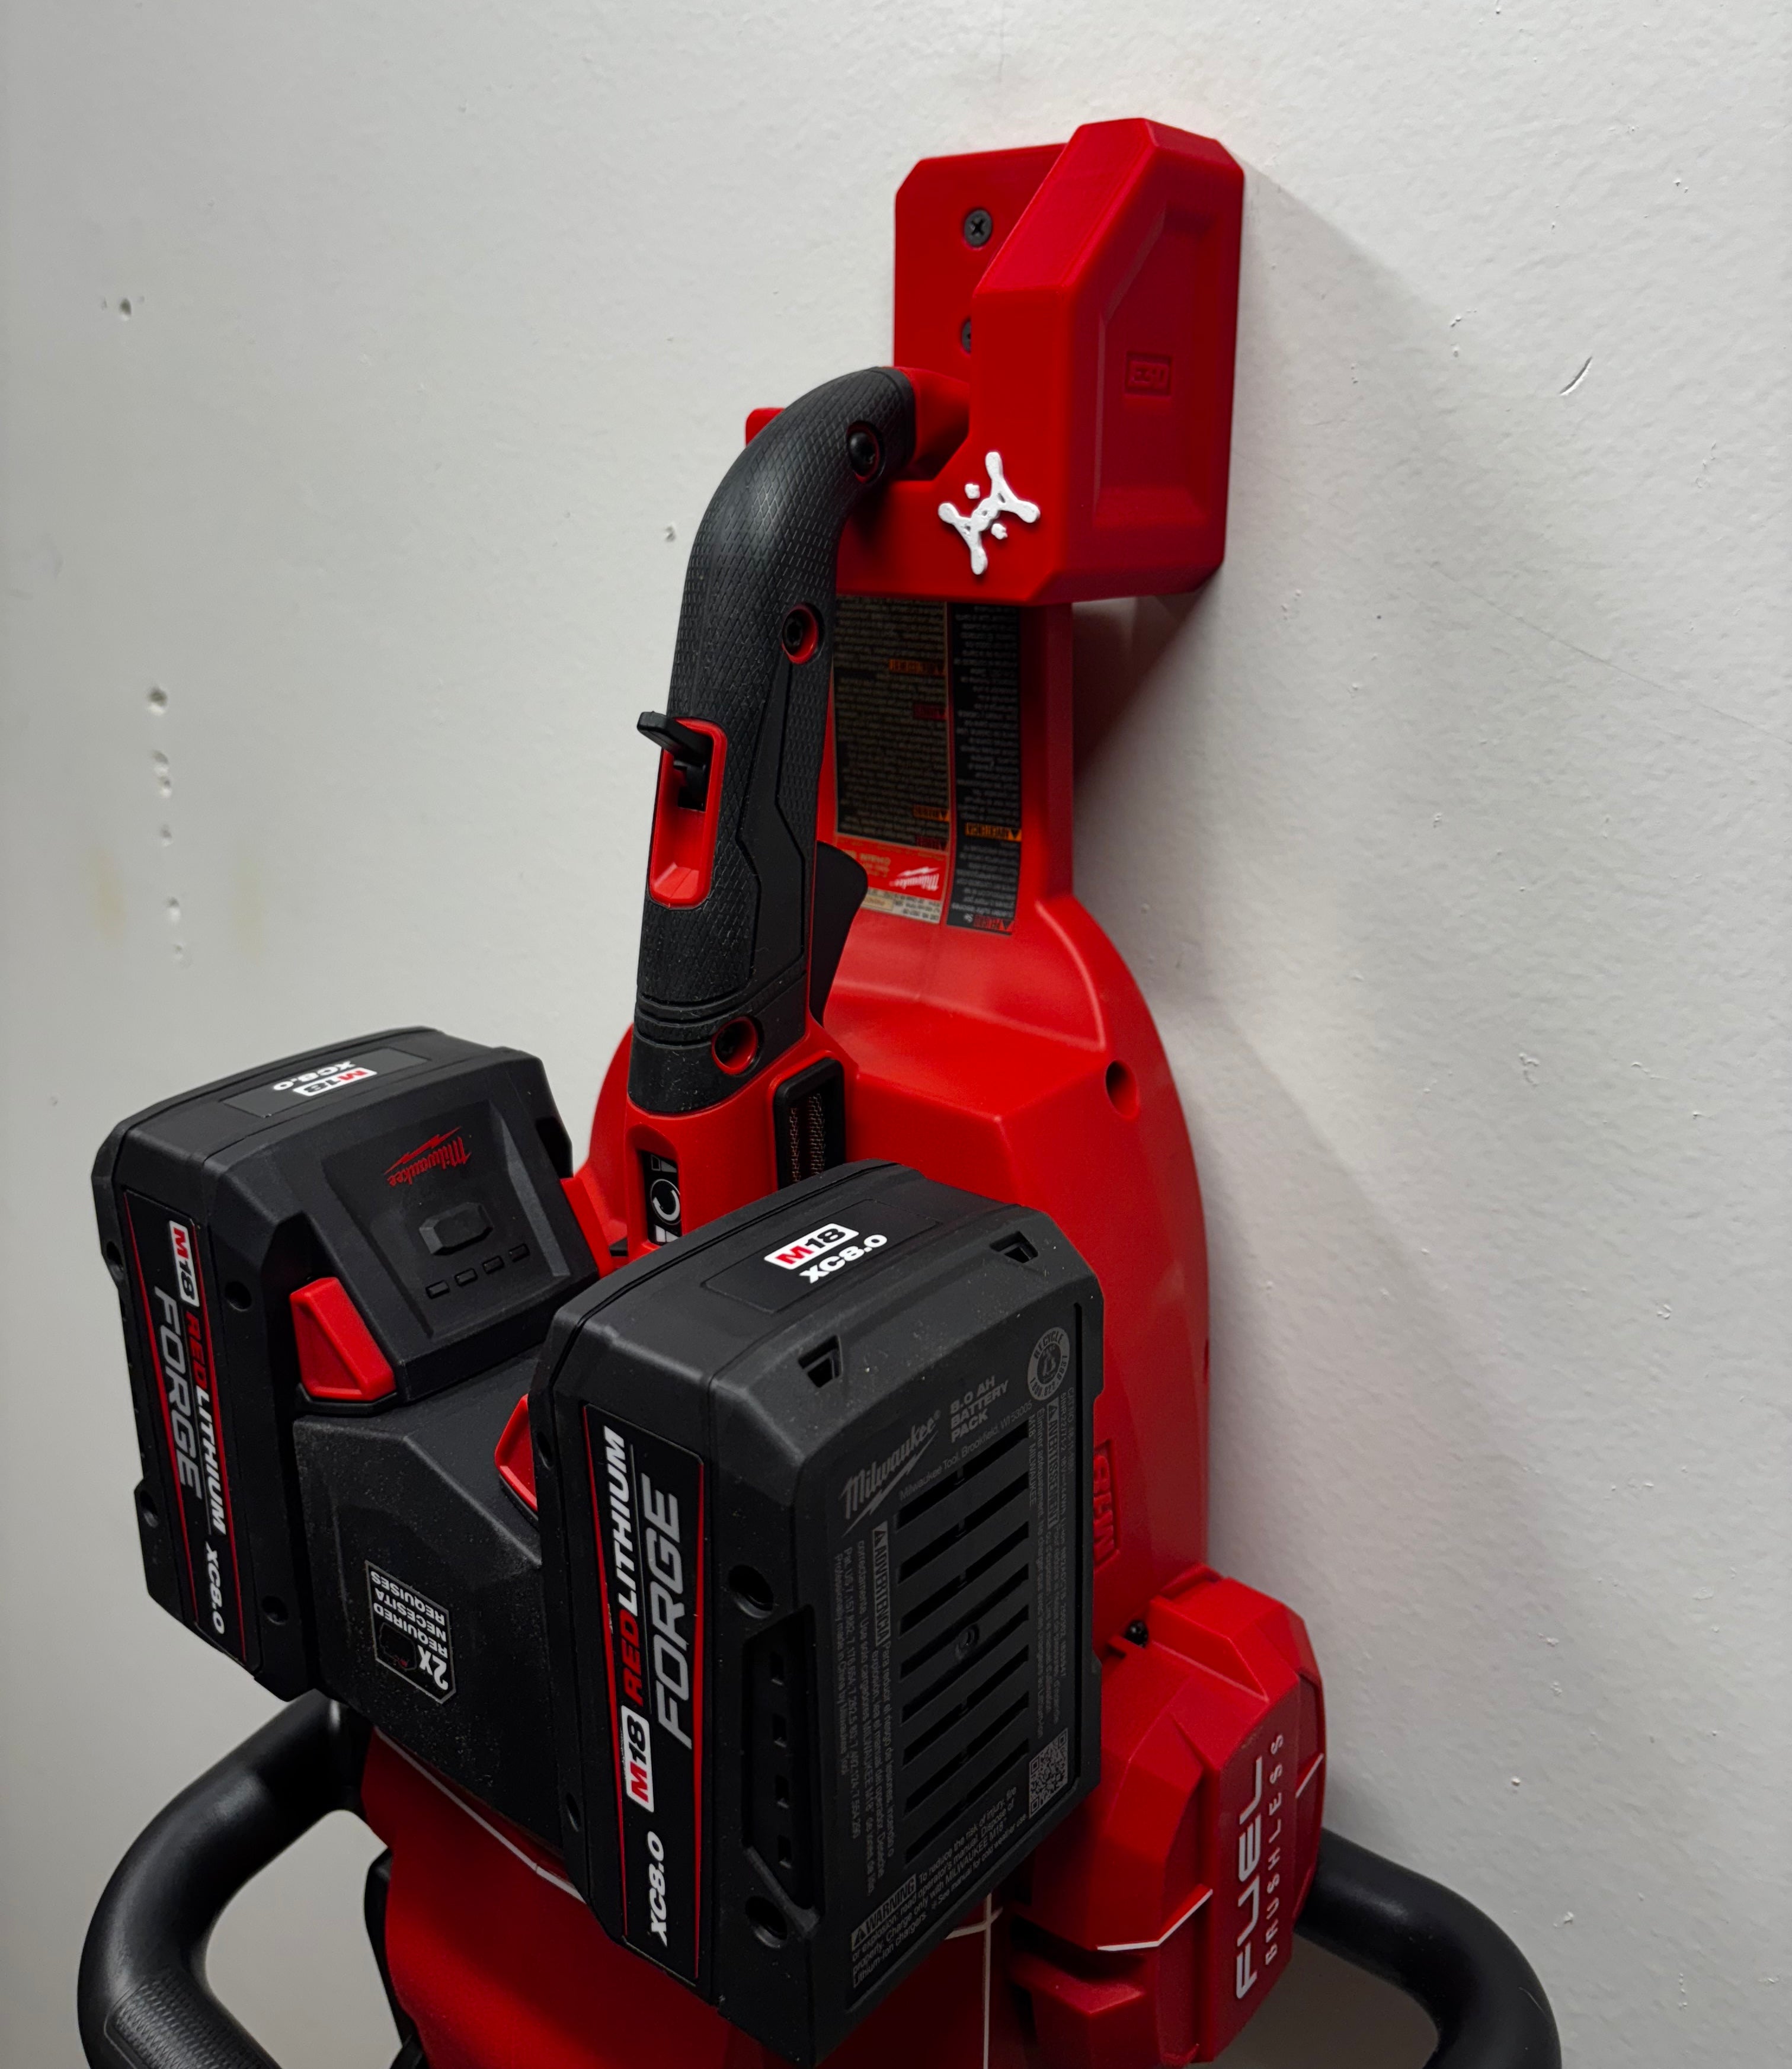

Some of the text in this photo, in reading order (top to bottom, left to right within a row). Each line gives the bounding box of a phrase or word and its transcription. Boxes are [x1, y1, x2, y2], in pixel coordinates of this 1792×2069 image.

[273, 1060, 356, 1091] XC8.0
[301, 1070, 370, 1093] M18
[387, 1136, 472, 1187] Milwaukee
[773, 1228, 847, 1265] M18
[799, 1234, 888, 1284] XC8.0
[1033, 1329, 1064, 1358] RECYCLE
[155, 1285, 201, 1499] FORGE
[950, 1376, 996, 1414] 8.0 AH
[951, 1380, 1009, 1430] BATTERY
[951, 1408, 988, 1443] PACK
[172, 1227, 226, 1635] M18 REDLITHIUM XC8.0
[900, 1465, 942, 1501] Milwaukee
[1012, 1400, 1032, 1422] 53005
[839, 1415, 936, 1520] Milwaukee
[1028, 1440, 1036, 1508] MILWAUKEE
[1048, 1416, 1058, 1527] AVERTISSEMENT
[370, 1571, 446, 1626] REQUISES
[375, 1588, 446, 1642] NECESITA
[642, 1472, 693, 1749] FORGE
[874, 1542, 889, 1644] ADVERTENCIA
[373, 1604, 448, 1658] REQUIRED
[417, 1645, 449, 1690] 2X
[603, 1425, 670, 1947] XC8.0 M18 REDLITHIUM
[862, 1718, 874, 1789] MILWAUKEE
[852, 1949, 860, 1964] or
[900, 1892, 916, 1917] read
[981, 1805, 1007, 1839] Dispose
[1007, 1796, 1015, 1814] of
[866, 1877, 914, 1936] WARNING
[918, 1867, 927, 1886] To
[929, 1844, 952, 1877] reduce
[953, 1833, 964, 1853] the
[965, 1819, 978, 1842] risk
[978, 1812, 985, 1829] of
[1006, 1782, 1016, 1802] fire
[1236, 1755, 1263, 1999] FUEL
[1265, 1734, 1284, 1965] BRUSHLESS
[886, 1909, 912, 1945] Charge
[913, 1893, 928, 1918] only
[930, 1878, 944, 1901] with
[945, 1834, 988, 1886] MILWAUKEE
